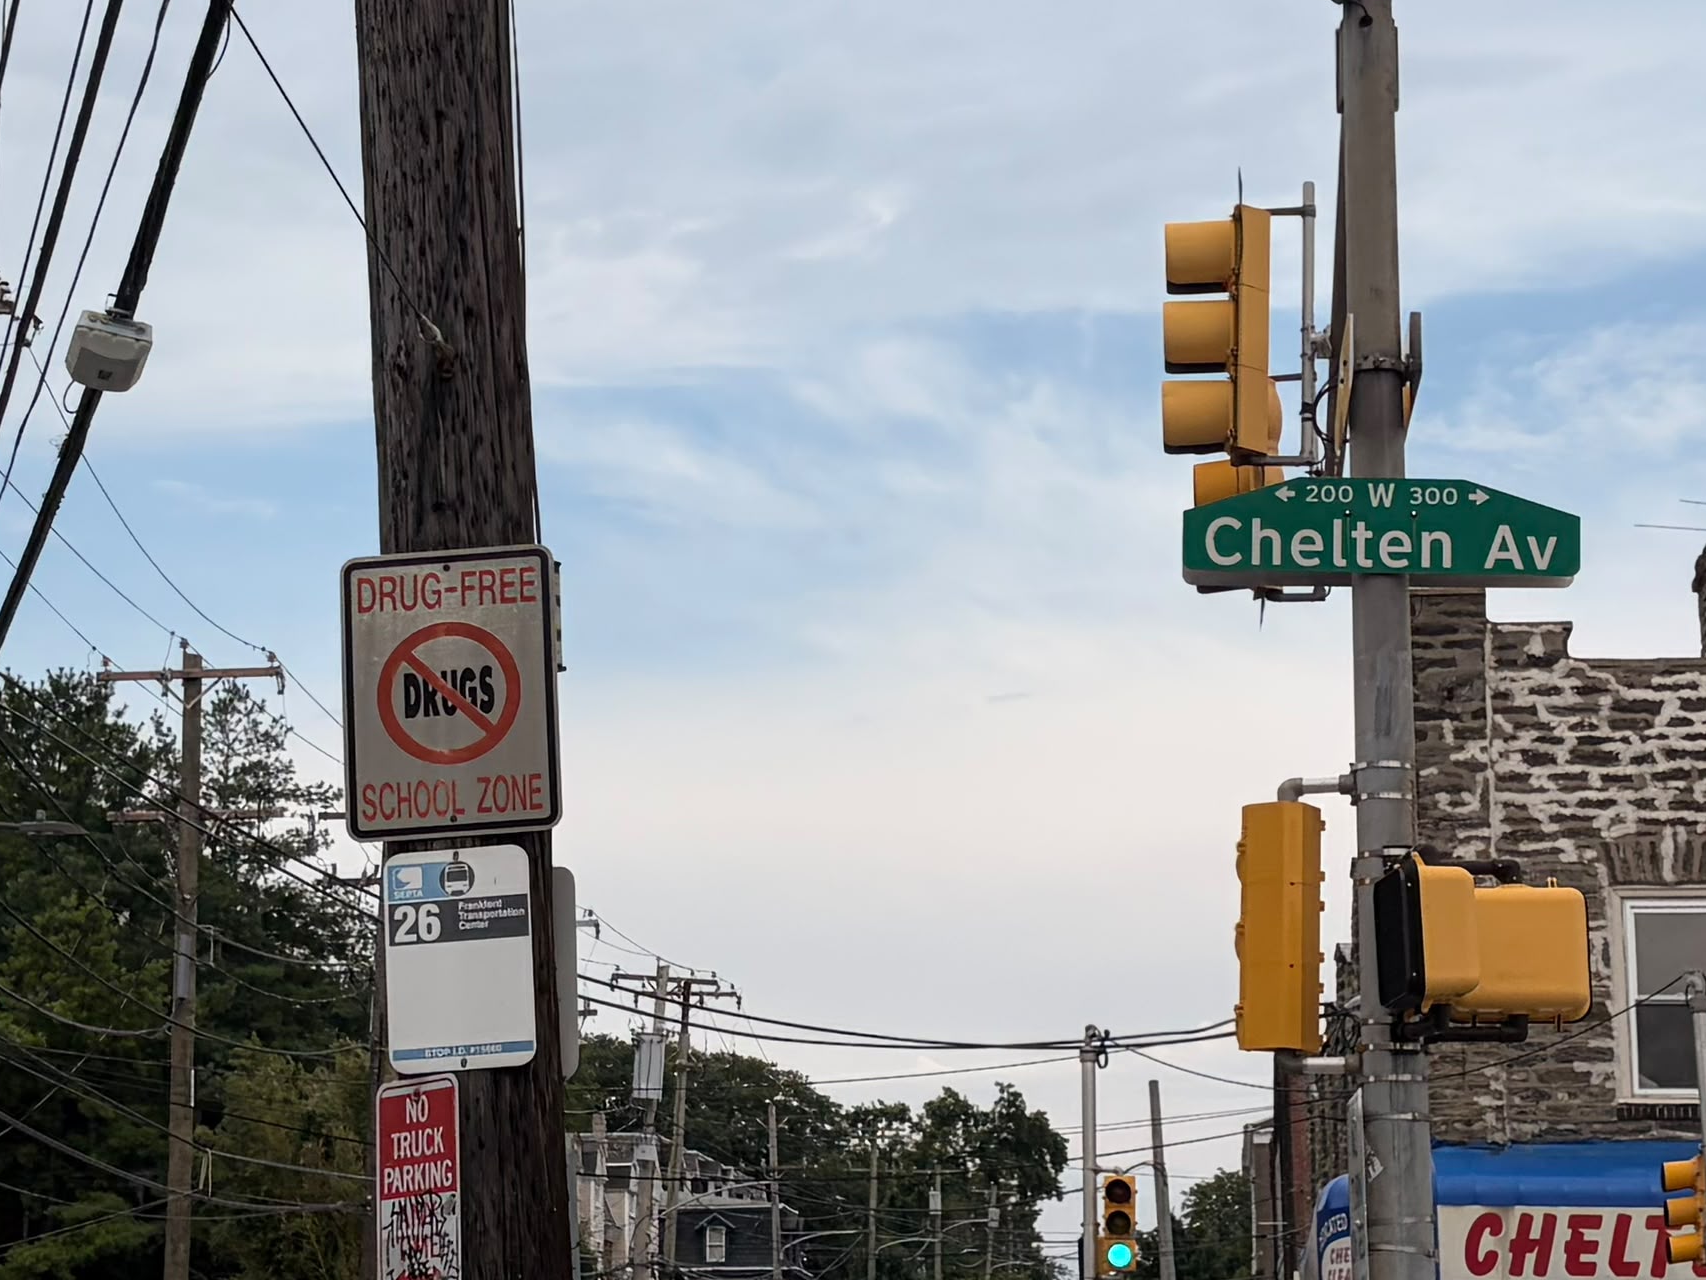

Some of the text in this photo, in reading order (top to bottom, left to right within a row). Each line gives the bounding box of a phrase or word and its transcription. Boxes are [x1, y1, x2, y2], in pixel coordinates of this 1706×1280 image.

[1305, 483, 1459, 508] 200 W 300
[1205, 517, 1558, 571] Chelten Av
[356, 566, 538, 614] DRUG-FREE
[403, 665, 496, 719] DRUGS
[362, 773, 543, 823] SCHOOL ZONE
[393, 889, 424, 899] SEPTA
[458, 899, 503, 911] Frankford
[394, 903, 442, 944] 26
[458, 908, 526, 920] Transportation
[458, 920, 490, 930] Center
[405, 1095, 429, 1124] NO
[391, 1126, 444, 1160] TRUCK
[384, 1159, 453, 1195] PARKING
